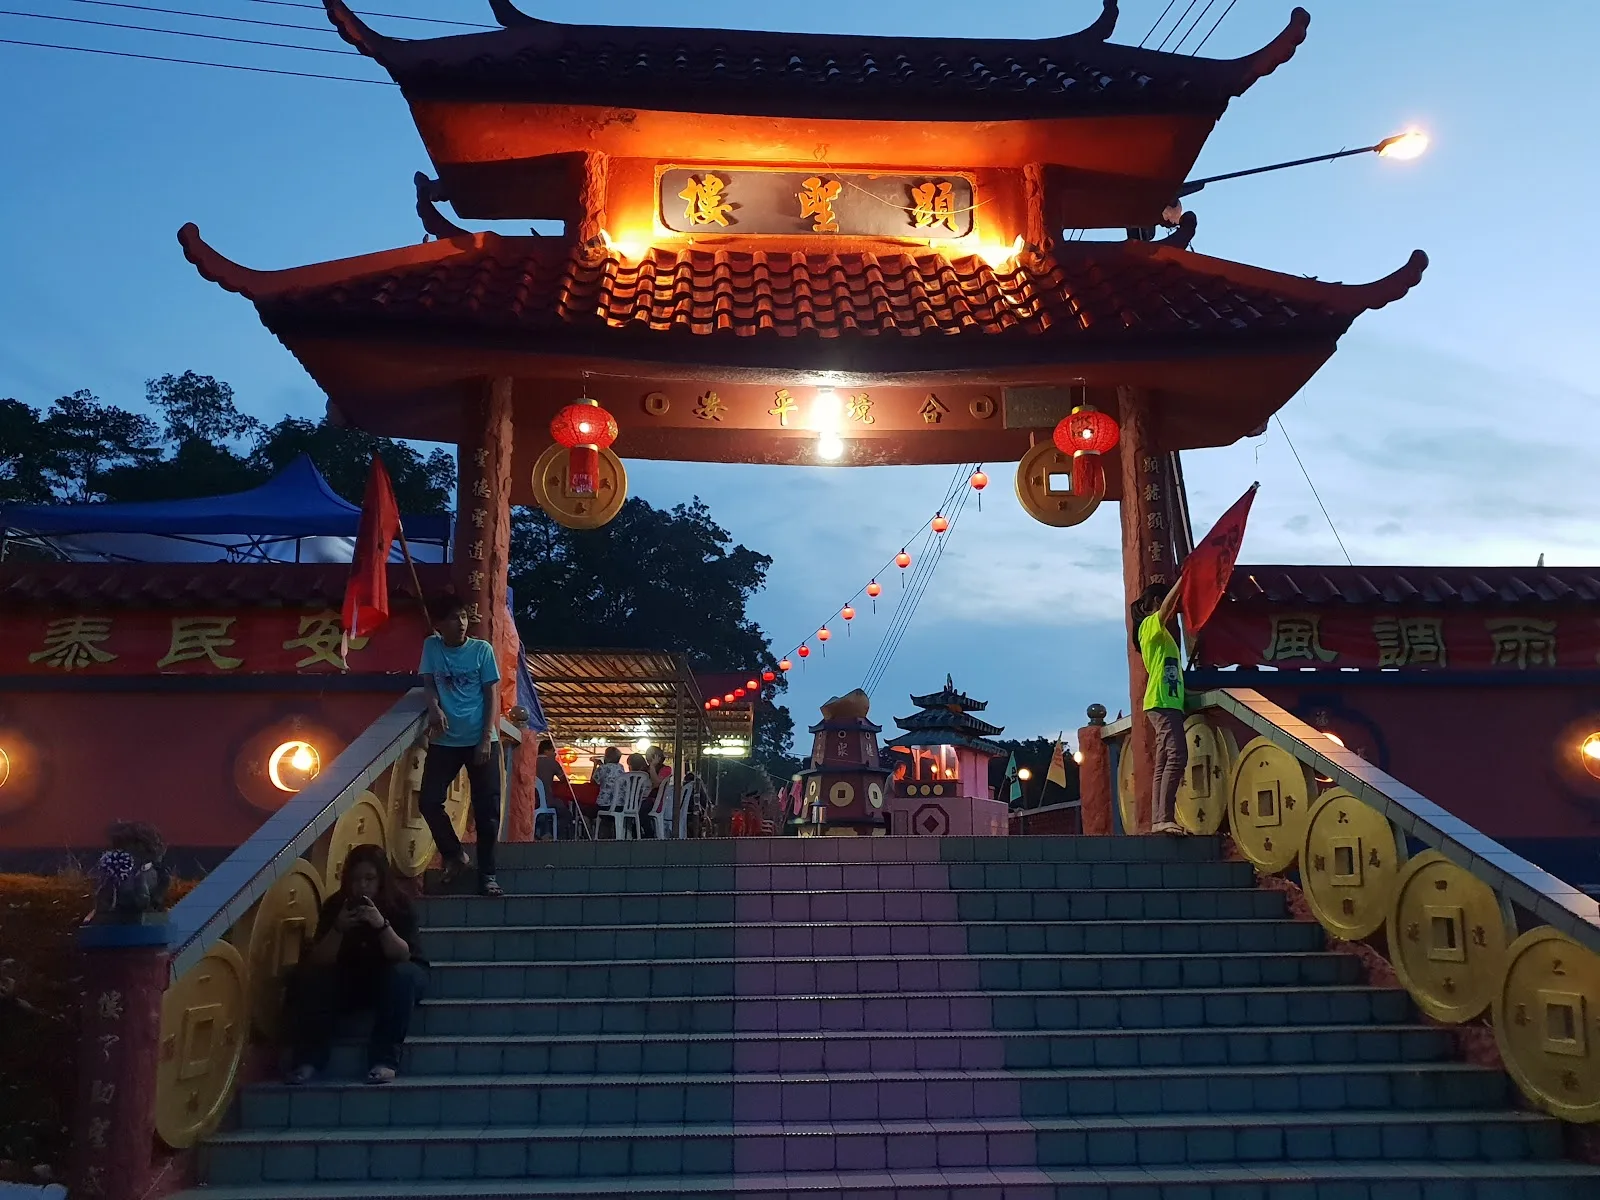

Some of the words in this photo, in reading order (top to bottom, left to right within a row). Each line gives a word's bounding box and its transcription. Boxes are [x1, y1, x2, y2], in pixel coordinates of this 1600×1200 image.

[28, 608, 372, 672] 泰民安
[1262, 612, 1600, 671] 風調雨
